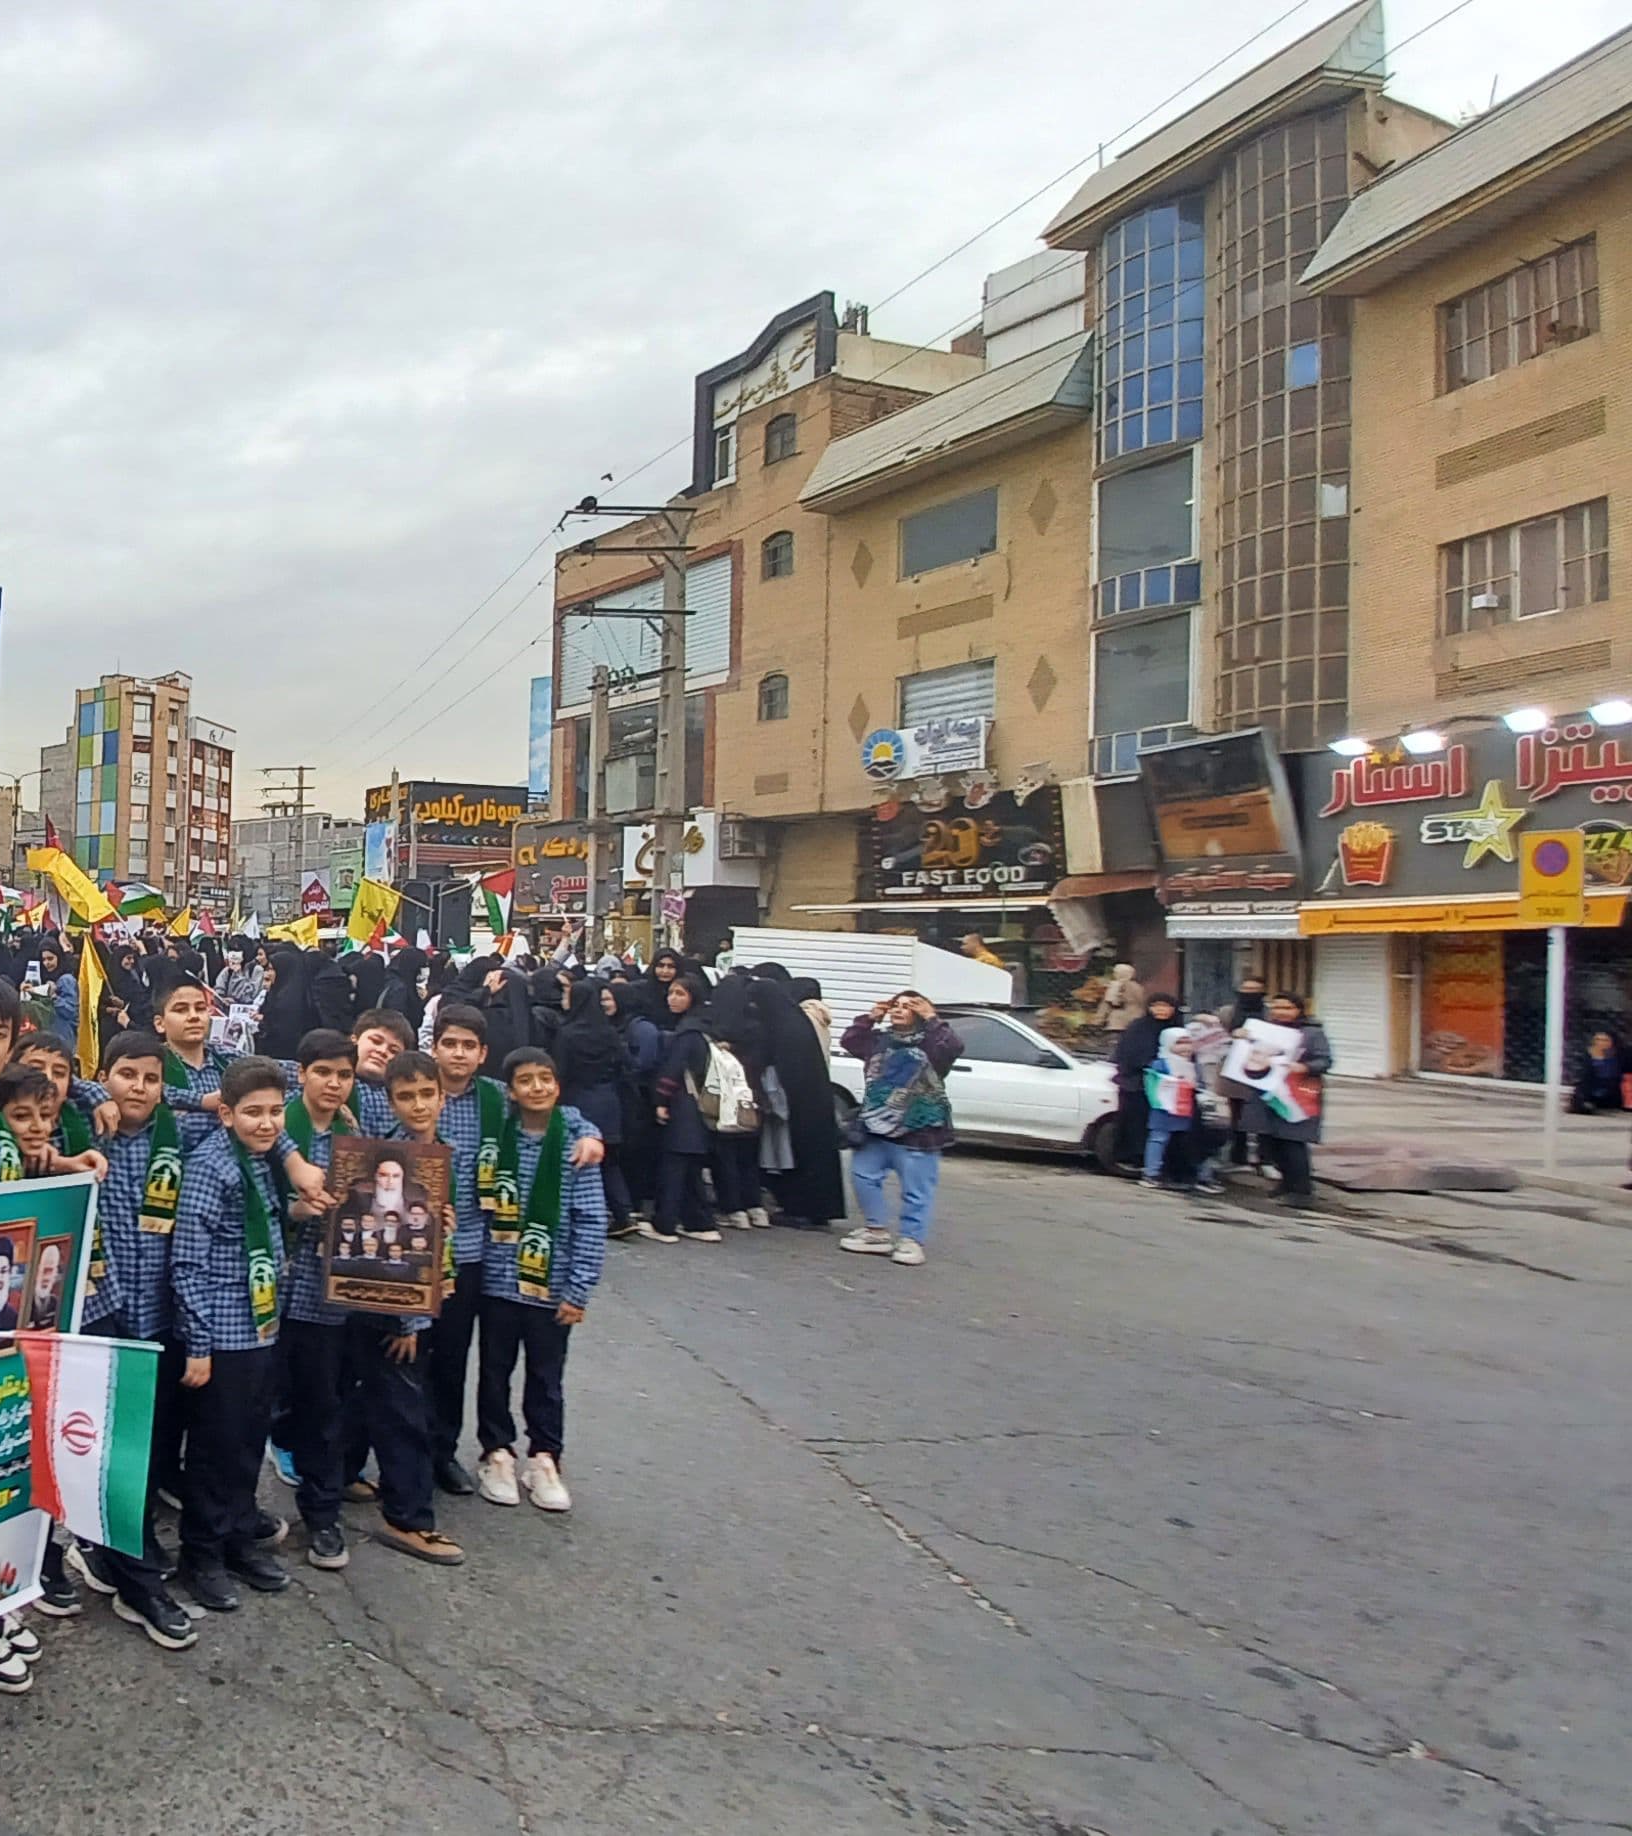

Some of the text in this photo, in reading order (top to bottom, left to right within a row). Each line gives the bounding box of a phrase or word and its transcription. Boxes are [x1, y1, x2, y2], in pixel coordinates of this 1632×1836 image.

[1516, 723, 1632, 804] یتزا
[1319, 743, 1466, 818] استار
[460, 797, 522, 828] سوخاری
[1424, 818, 1498, 842] STAR
[902, 865, 1027, 887] FAST FOOD
